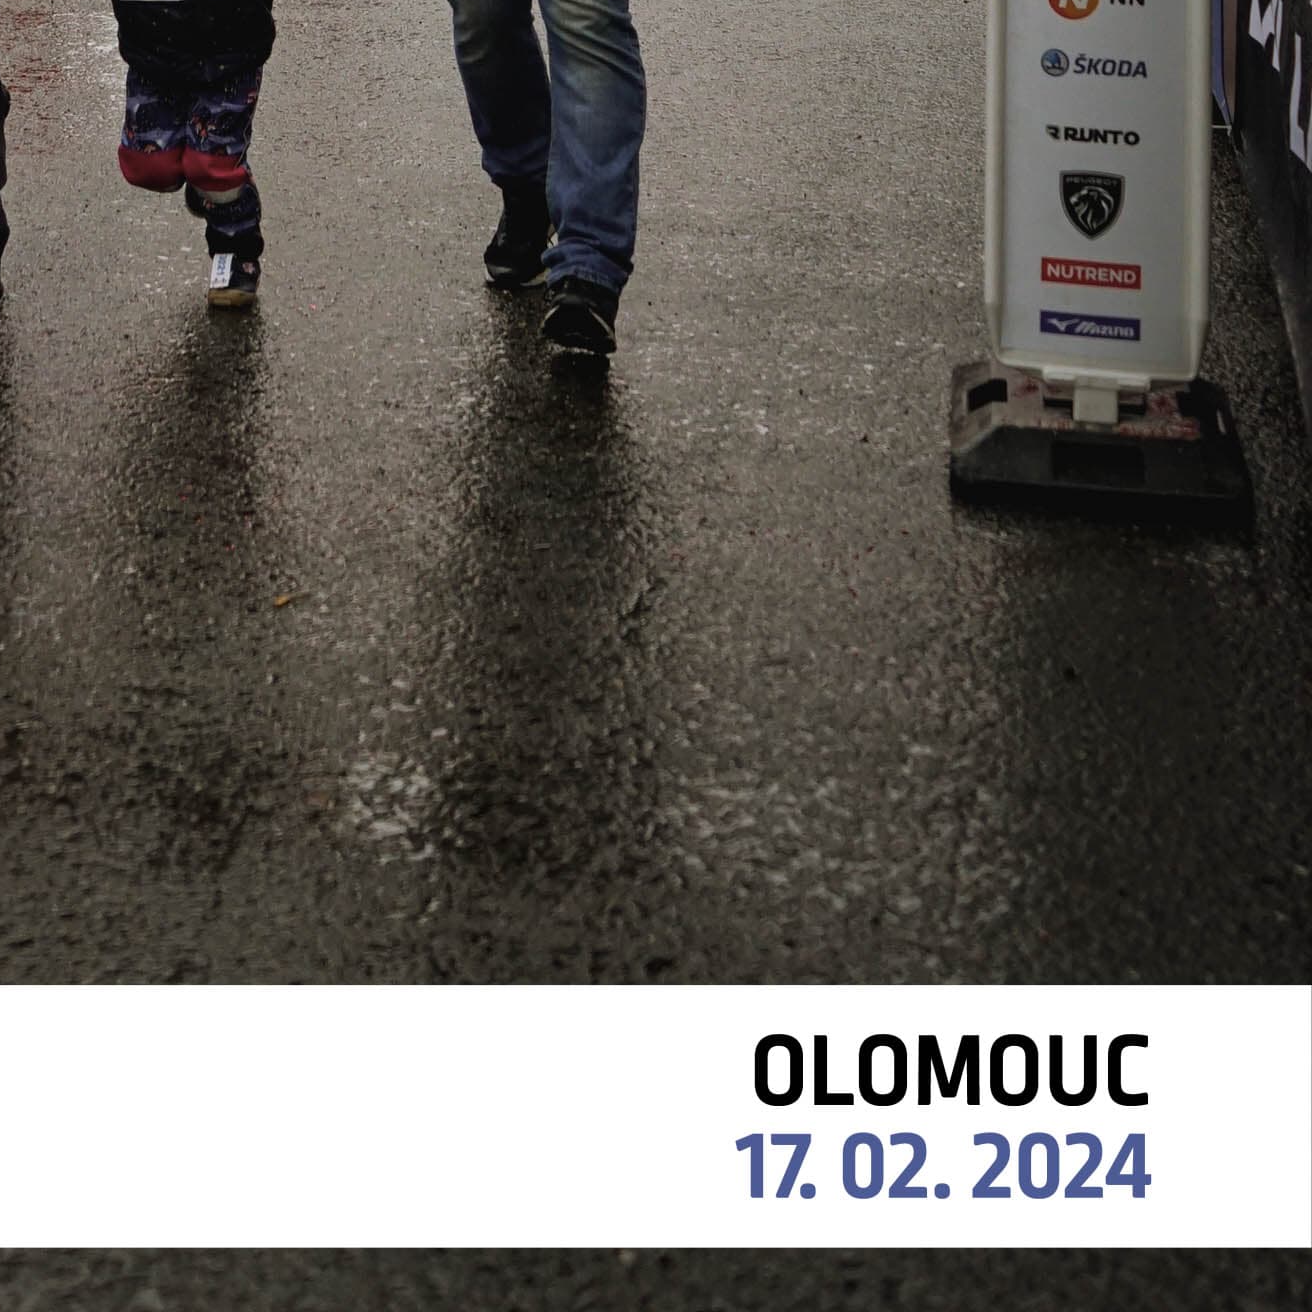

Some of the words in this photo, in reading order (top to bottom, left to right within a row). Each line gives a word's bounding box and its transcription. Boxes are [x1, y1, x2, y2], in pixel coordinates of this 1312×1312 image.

[1073, 53, 1148, 78] ŠKODA
[1064, 127, 1140, 146] RUNTO
[1046, 264, 1137, 284] NUTREND
